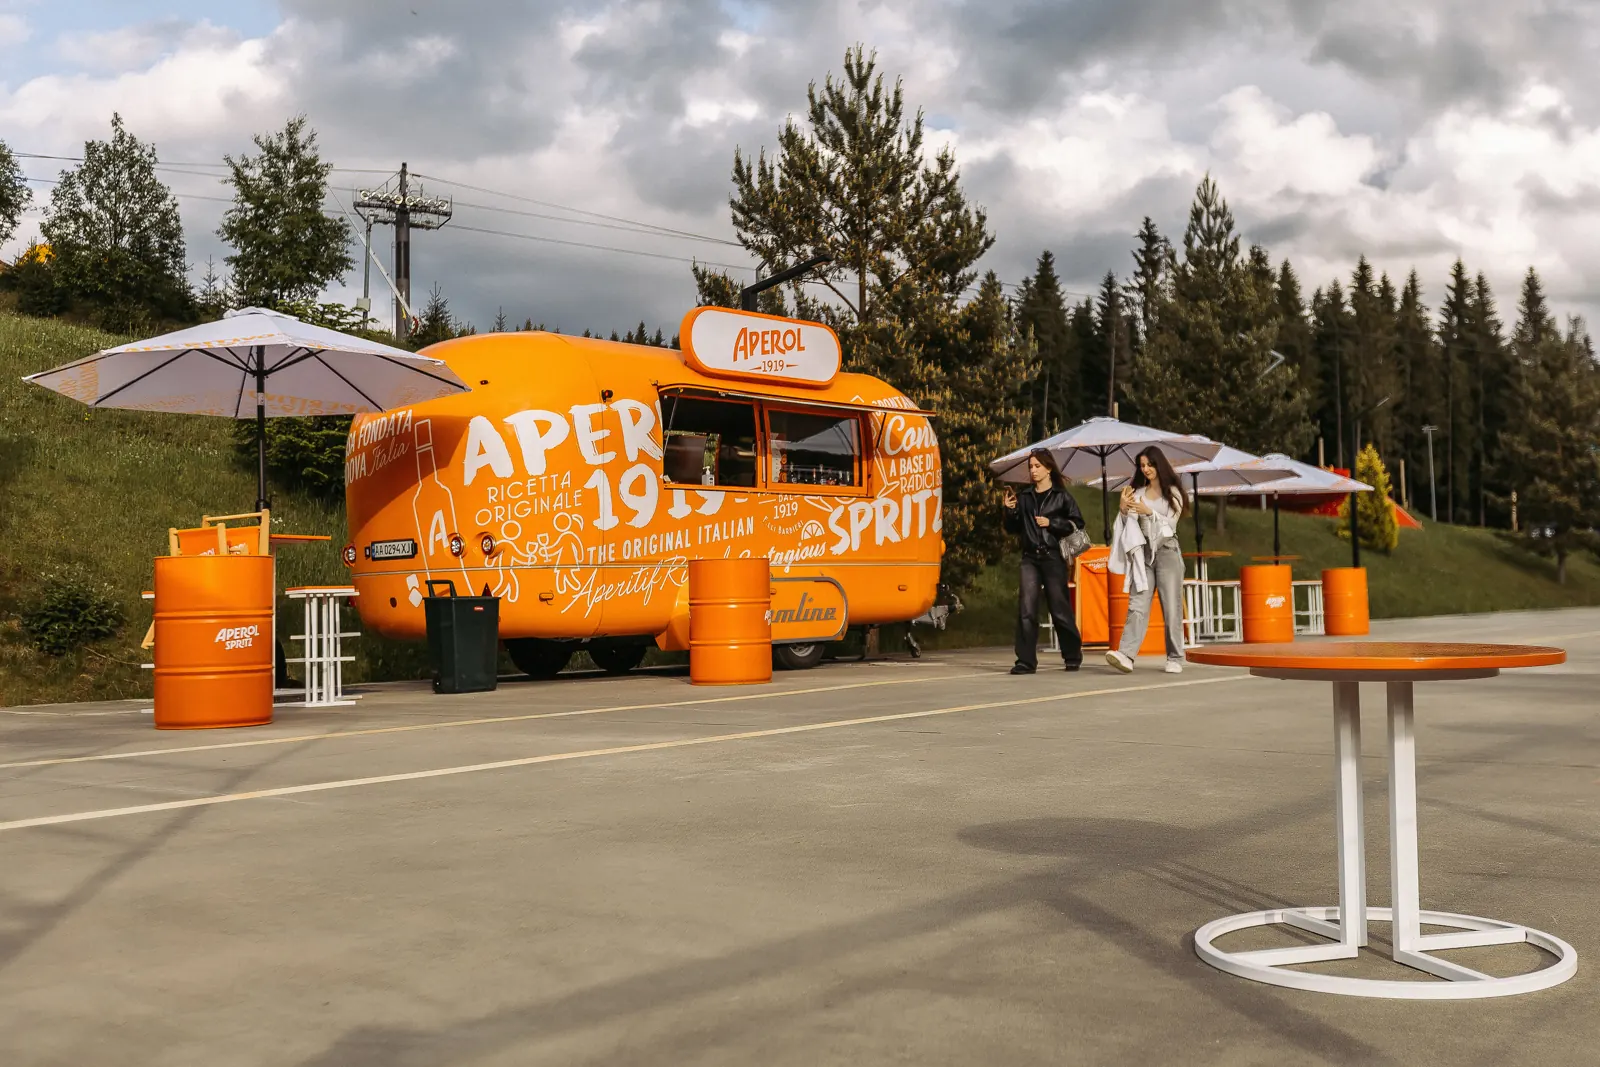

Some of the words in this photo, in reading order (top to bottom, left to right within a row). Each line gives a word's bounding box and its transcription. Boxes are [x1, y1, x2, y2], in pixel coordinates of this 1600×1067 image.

[733, 327, 805, 362] APEROL
[762, 360, 784, 372] 1919
[357, 409, 412, 449] FONDATA
[463, 399, 663, 486] APER
[367, 436, 410, 477] Italia
[889, 459, 897, 478] A
[900, 454, 923, 475] BASE
[926, 453, 934, 471] DI
[487, 470, 571, 503] RICETTA
[778, 494, 793, 503] DAL
[900, 471, 934, 493] RADICI
[475, 489, 582, 526] ORIGINALE
[773, 501, 798, 520] 1919
[376, 545, 384, 555] AA
[384, 543, 400, 555] 0294
[401, 542, 411, 554] XJ
[429, 509, 450, 556] A
[587, 543, 615, 566] THE
[623, 529, 691, 559] ORIGINAL
[698, 516, 754, 545] ITALIAN
[561, 559, 663, 618] Aperitif
[214, 625, 260, 643] APEROL
[225, 638, 253, 650] SPRITZ
